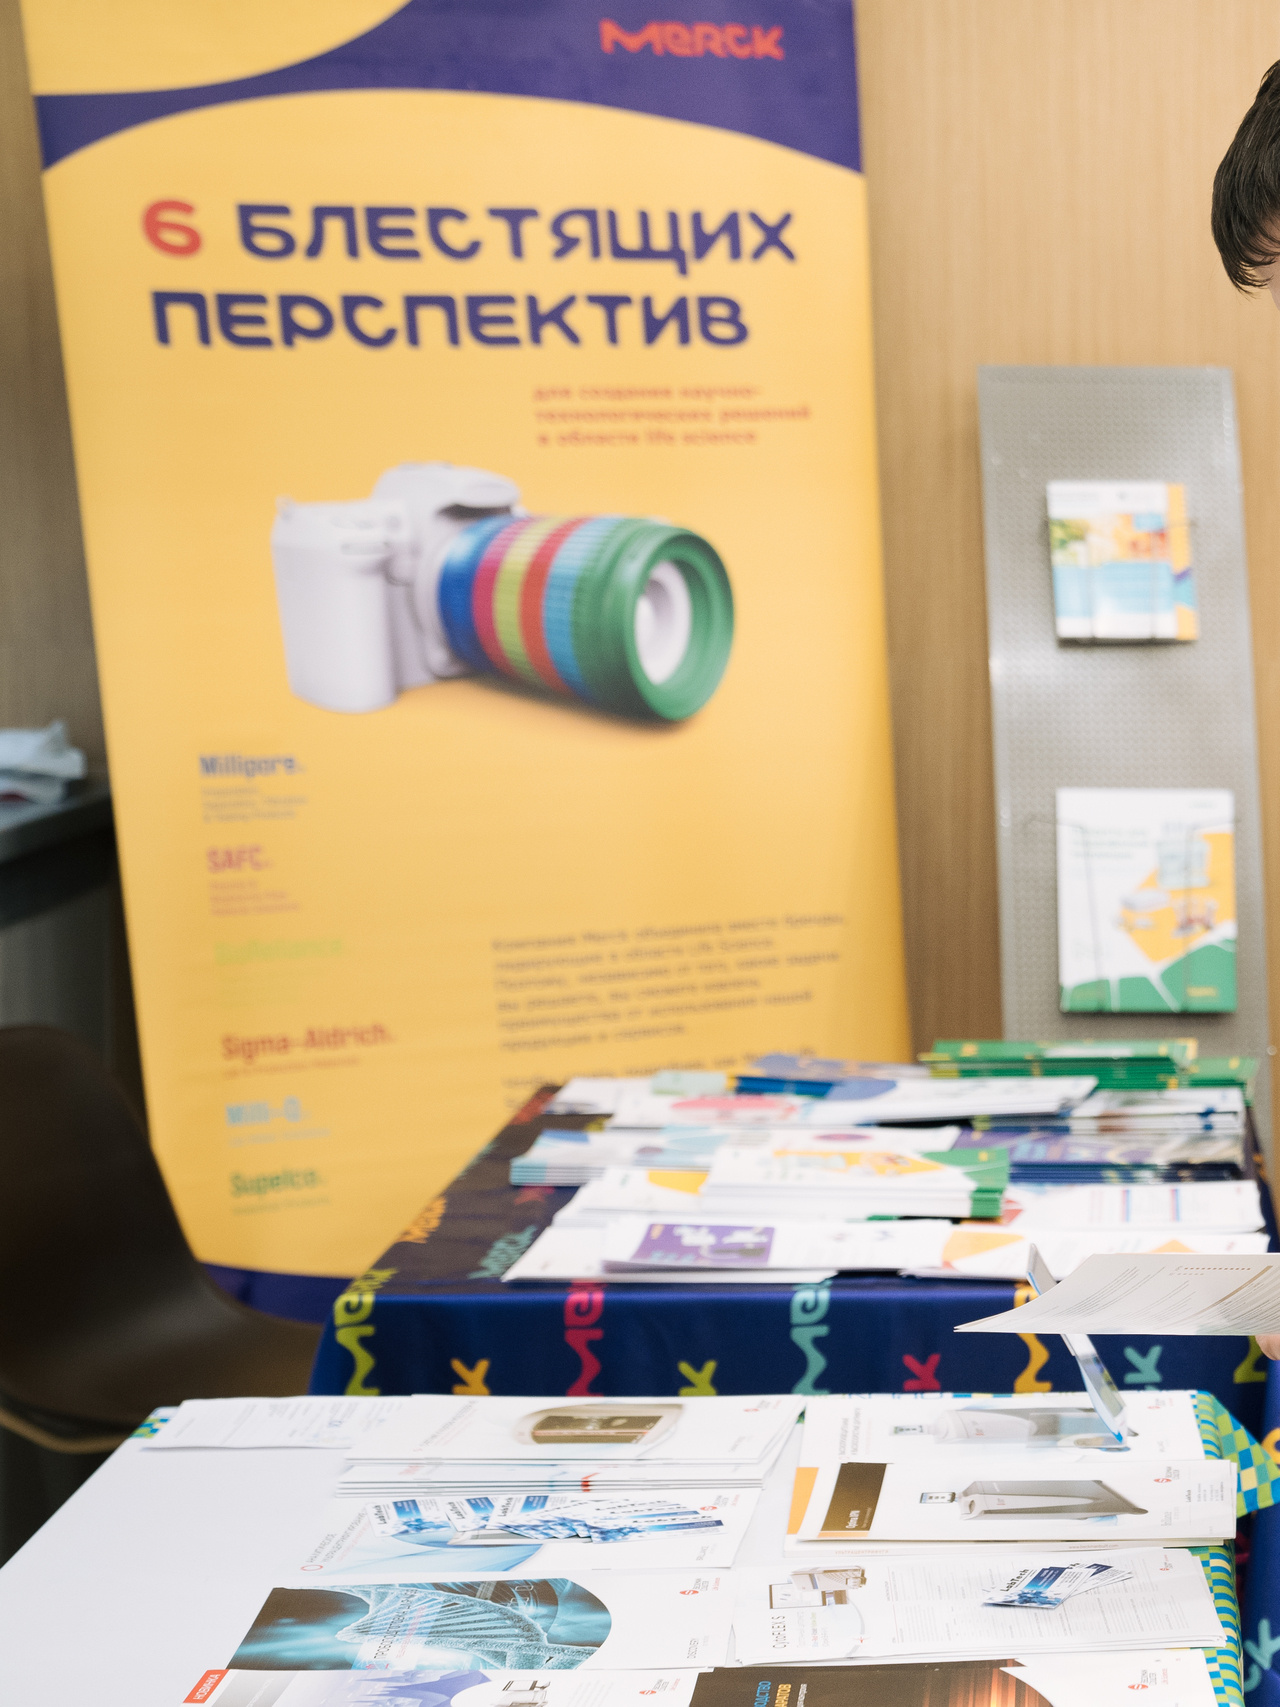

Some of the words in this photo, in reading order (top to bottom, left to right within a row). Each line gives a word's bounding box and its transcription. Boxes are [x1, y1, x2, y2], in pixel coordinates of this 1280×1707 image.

[142, 199, 203, 258] 6
[237, 203, 798, 276] БЛЕСТЯЩИХ
[151, 290, 751, 350] ПЕРСПЕКТИВ
[999, 1568, 1030, 1592] LabTech
[192, 1673, 222, 1700] НОВИНКА
[753, 1680, 772, 1707] ОДСТВО
